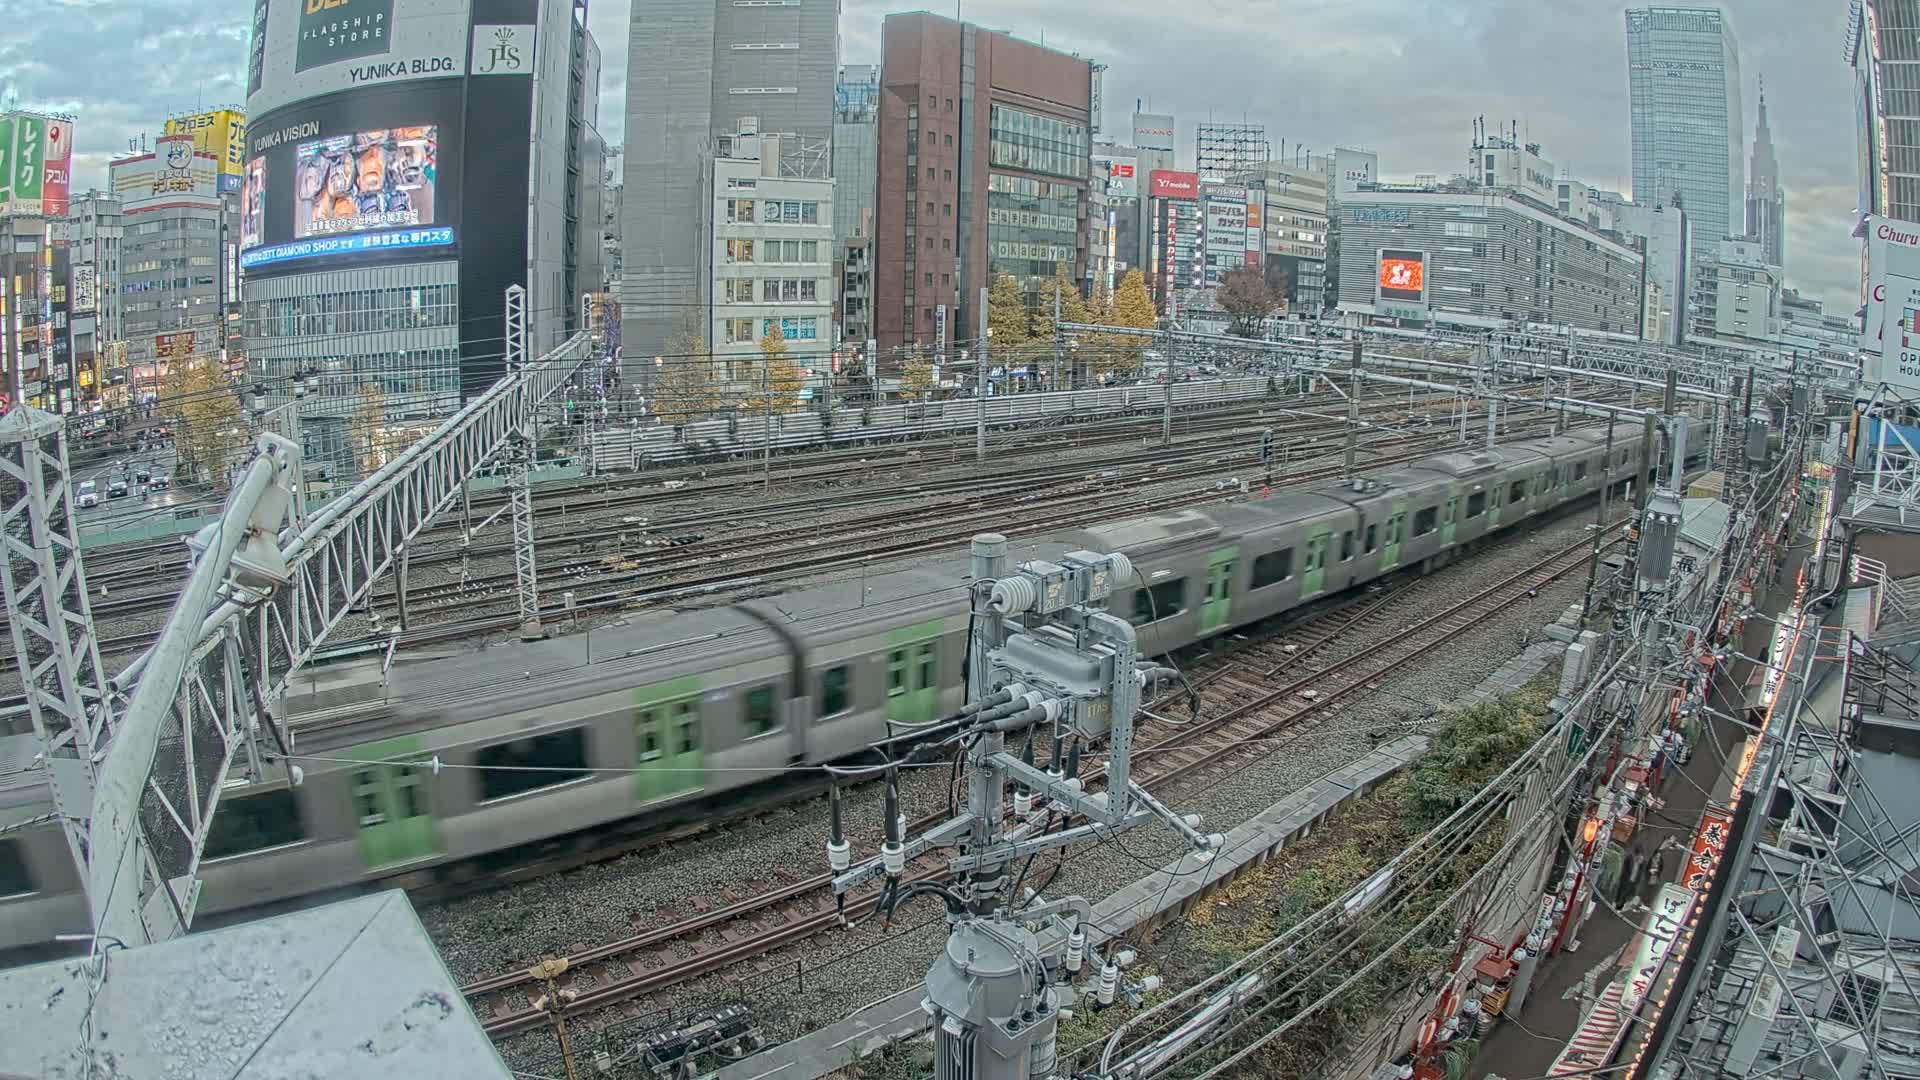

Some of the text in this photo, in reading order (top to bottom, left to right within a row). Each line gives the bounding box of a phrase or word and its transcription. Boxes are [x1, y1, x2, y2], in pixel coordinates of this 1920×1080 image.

[303, 13, 384, 40] FLAGSHIP
[328, 28, 382, 47] STORE
[350, 56, 456, 83] YUNIKA BLDG.
[175, 116, 215, 132] プロミス
[255, 131, 281, 153] YUNIKA
[282, 121, 320, 143] VISION
[21, 120, 38, 188] レイク
[45, 168, 69, 185] アコム
[275, 242, 312, 258] DIAMOND
[313, 240, 338, 253] SHOP
